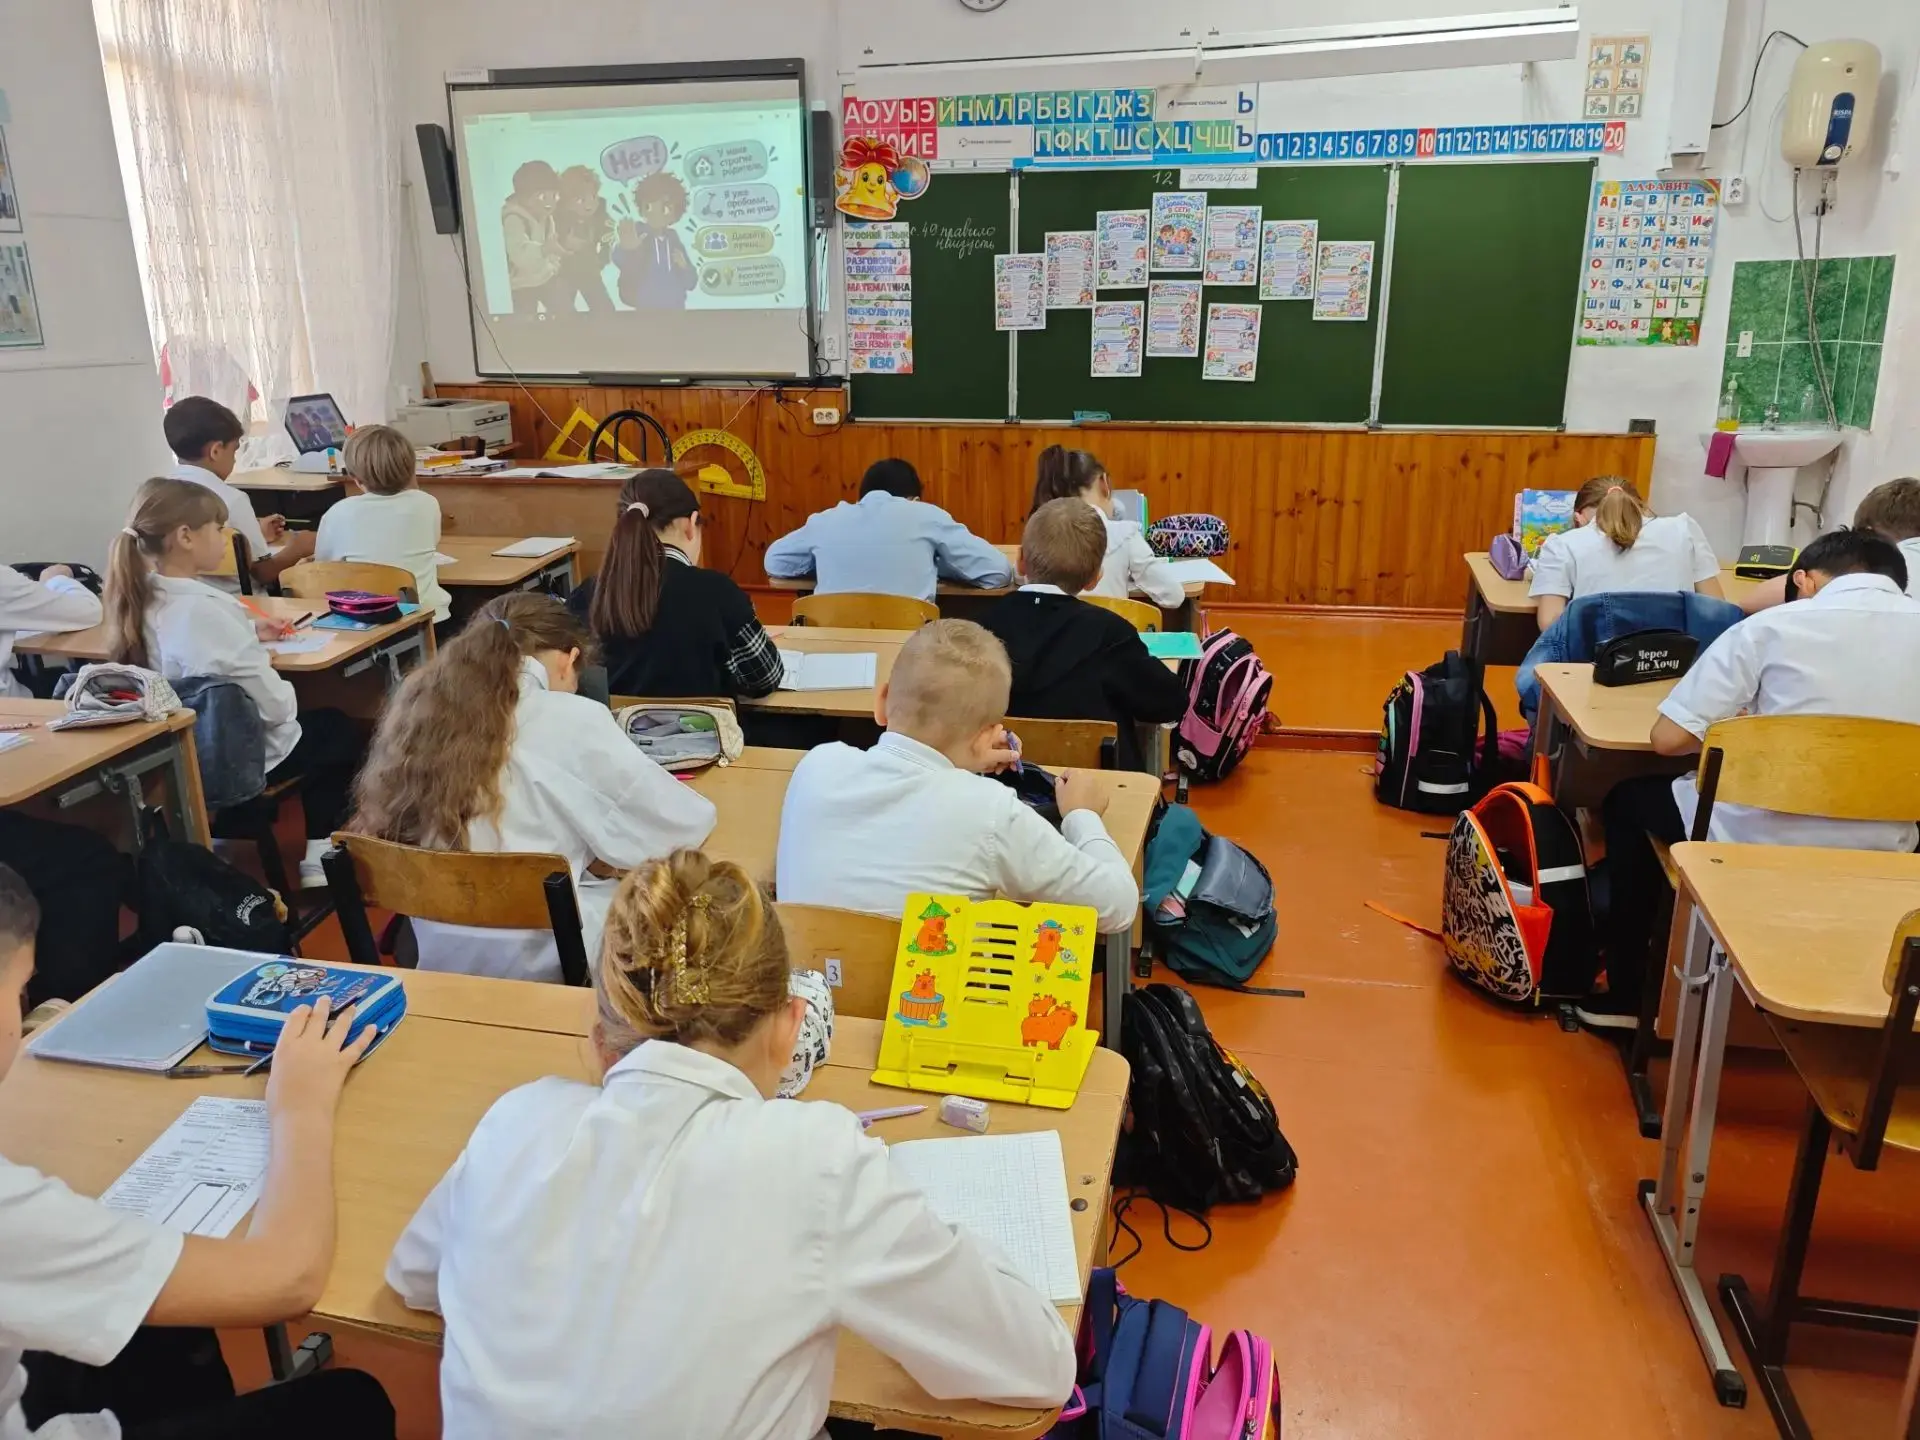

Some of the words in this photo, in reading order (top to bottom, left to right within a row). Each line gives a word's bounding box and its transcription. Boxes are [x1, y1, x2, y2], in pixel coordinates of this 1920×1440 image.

[1260, 139, 1270, 157] 0
[1277, 138, 1284, 157] 1
[1291, 137, 1301, 156] 2
[1307, 137, 1317, 156] 3
[1322, 136, 1333, 155] 4
[1338, 135, 1349, 155] 5
[1355, 135, 1365, 154] 6
[1372, 135, 1382, 154] 7
[1388, 134, 1398, 153] 8
[1404, 133, 1414, 153] 9
[1419, 133, 1433, 153] 10
[1438, 133, 1451, 151] 11
[1456, 132, 1471, 151] 12
[1475, 132, 1489, 150] 13
[1493, 131, 1509, 150] 14
[1513, 130, 1527, 149] 15
[1531, 130, 1546, 149] 16
[1551, 129, 1566, 148] 17
[1569, 129, 1584, 148] 18
[1588, 128, 1603, 147] 19
[1605, 127, 1623, 147] 20
[608, 141, 661, 174] Нет!
[1152, 171, 1173, 186] 12
[1626, 181, 1691, 192] АЛФАВИТ
[1600, 196, 1608, 207] А
[1624, 196, 1632, 206] Б
[1648, 195, 1657, 205] В
[1672, 195, 1679, 204] Г
[1694, 194, 1704, 206] Д
[1597, 218, 1605, 227] Е
[1622, 214, 1630, 227] Ё
[1644, 216, 1656, 226] Ж
[1670, 216, 1677, 226] З
[1692, 216, 1702, 225] И
[922, 222, 938, 237] 49
[940, 218, 996, 237] правило
[1595, 235, 1604, 248] Й
[1619, 238, 1628, 248] К
[1641, 237, 1651, 247] Л
[1665, 237, 1676, 247] М
[1689, 237, 1699, 247] Н
[936, 238, 995, 259] наизусть
[846, 256, 897, 265] РАЗГОВОРЫ
[1592, 259, 1602, 268] О
[1616, 259, 1625, 269] П
[1639, 258, 1647, 268] Р
[1662, 258, 1671, 268] С
[1688, 258, 1696, 267] Т
[847, 265, 853, 273] О
[855, 265, 893, 273] ВАЖНОМ
[847, 282, 910, 292] МАТЕМАТИКА
[1590, 279, 1599, 288] У
[1612, 279, 1623, 288] Ф
[1636, 279, 1644, 288] Х
[1660, 279, 1669, 290] Ц
[1684, 279, 1692, 288] Ч
[1587, 299, 1597, 309] Ш
[1610, 299, 1620, 311] Щ
[1634, 299, 1642, 309] Ъ
[1656, 299, 1666, 309] Ы
[1681, 299, 1688, 308] Ь
[848, 307, 910, 317] ФИЗКУЛЬТУРА
[1584, 320, 1593, 329] Э
[1606, 320, 1618, 329] Ю
[1631, 320, 1639, 329] Я
[854, 331, 906, 340] АНГЛИЙСКИЙ
[868, 340, 892, 348] ЯЗЫК
[869, 356, 895, 369] ИЗО
[1638, 650, 1668, 661] Через
[1636, 660, 1650, 671] Не
[1652, 659, 1679, 670] Хочу
[829, 965, 838, 982] 3
